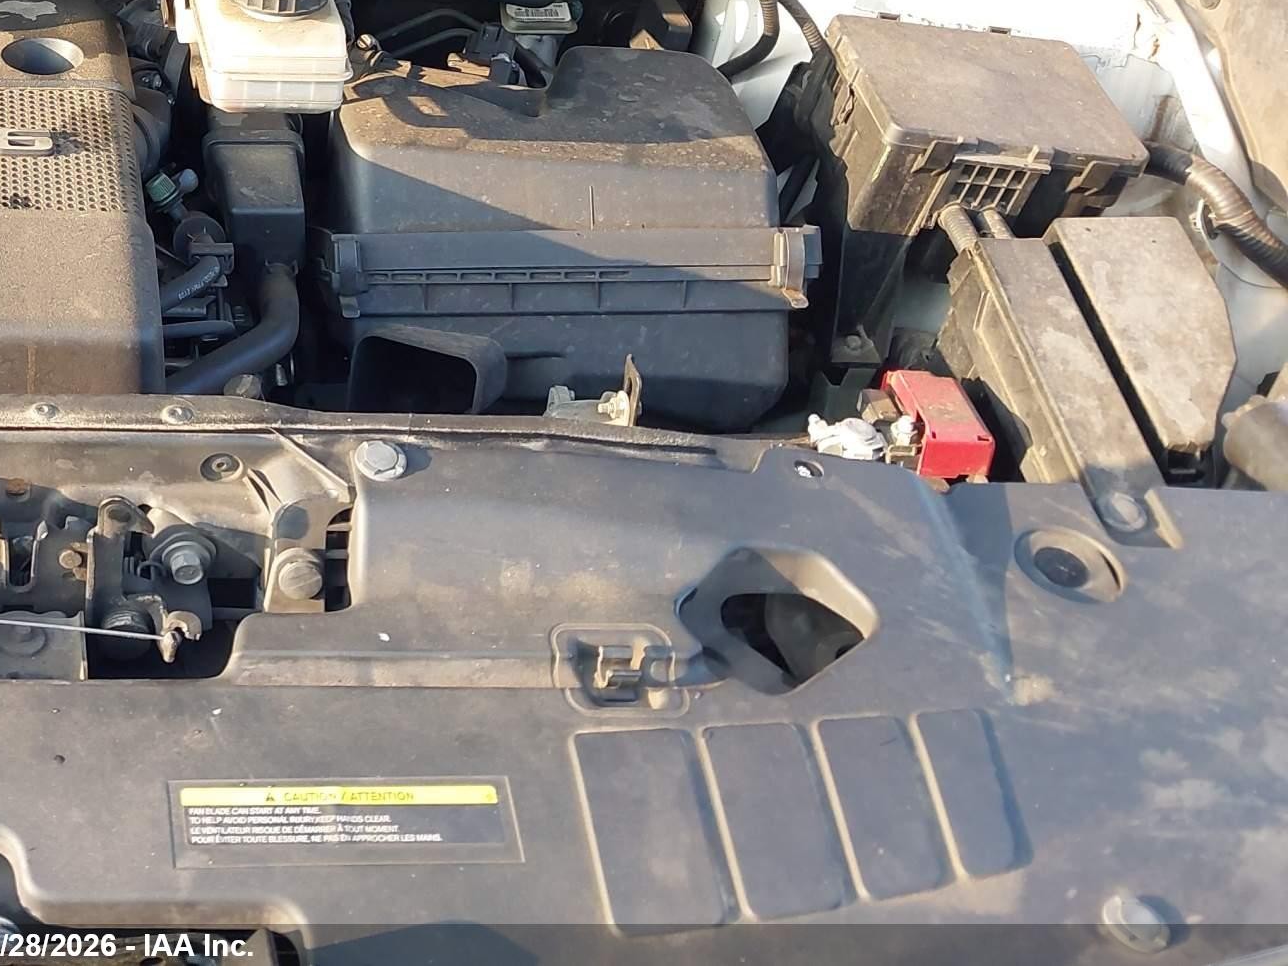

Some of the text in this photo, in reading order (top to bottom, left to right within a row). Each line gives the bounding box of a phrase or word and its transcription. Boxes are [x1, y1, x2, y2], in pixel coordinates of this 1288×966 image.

[284, 791, 337, 802] CAUTION
[350, 791, 414, 802] ATTENTION
[188, 807, 204, 815] FAN
[205, 807, 230, 815] BLADE
[231, 807, 248, 815] CAN
[249, 807, 273, 815] START
[274, 806, 284, 814] AT
[285, 806, 301, 814] ANY
[190, 816, 201, 824] TO
[201, 816, 222, 824] HELP
[223, 816, 247, 824] AVOID
[247, 816, 289, 824] PERSONAL
[336, 815, 363, 823] HANDS
[190, 826, 201, 835] LE
[202, 826, 251, 835] VENTILATEUR
[252, 825, 281, 834] RISQUE
[282, 825, 293, 834] DE
[294, 823, 336, 834] DÉMARRER
[344, 825, 364, 833] TOUT
[192, 836, 214, 844] POUR
[215, 834, 242, 843] ÉVITER
[243, 835, 267, 843] TOUTE
[311, 835, 322, 843] NE
[323, 834, 340, 843] PAS
[352, 834, 400, 842] APPROCHER
[401, 834, 415, 842] LES
